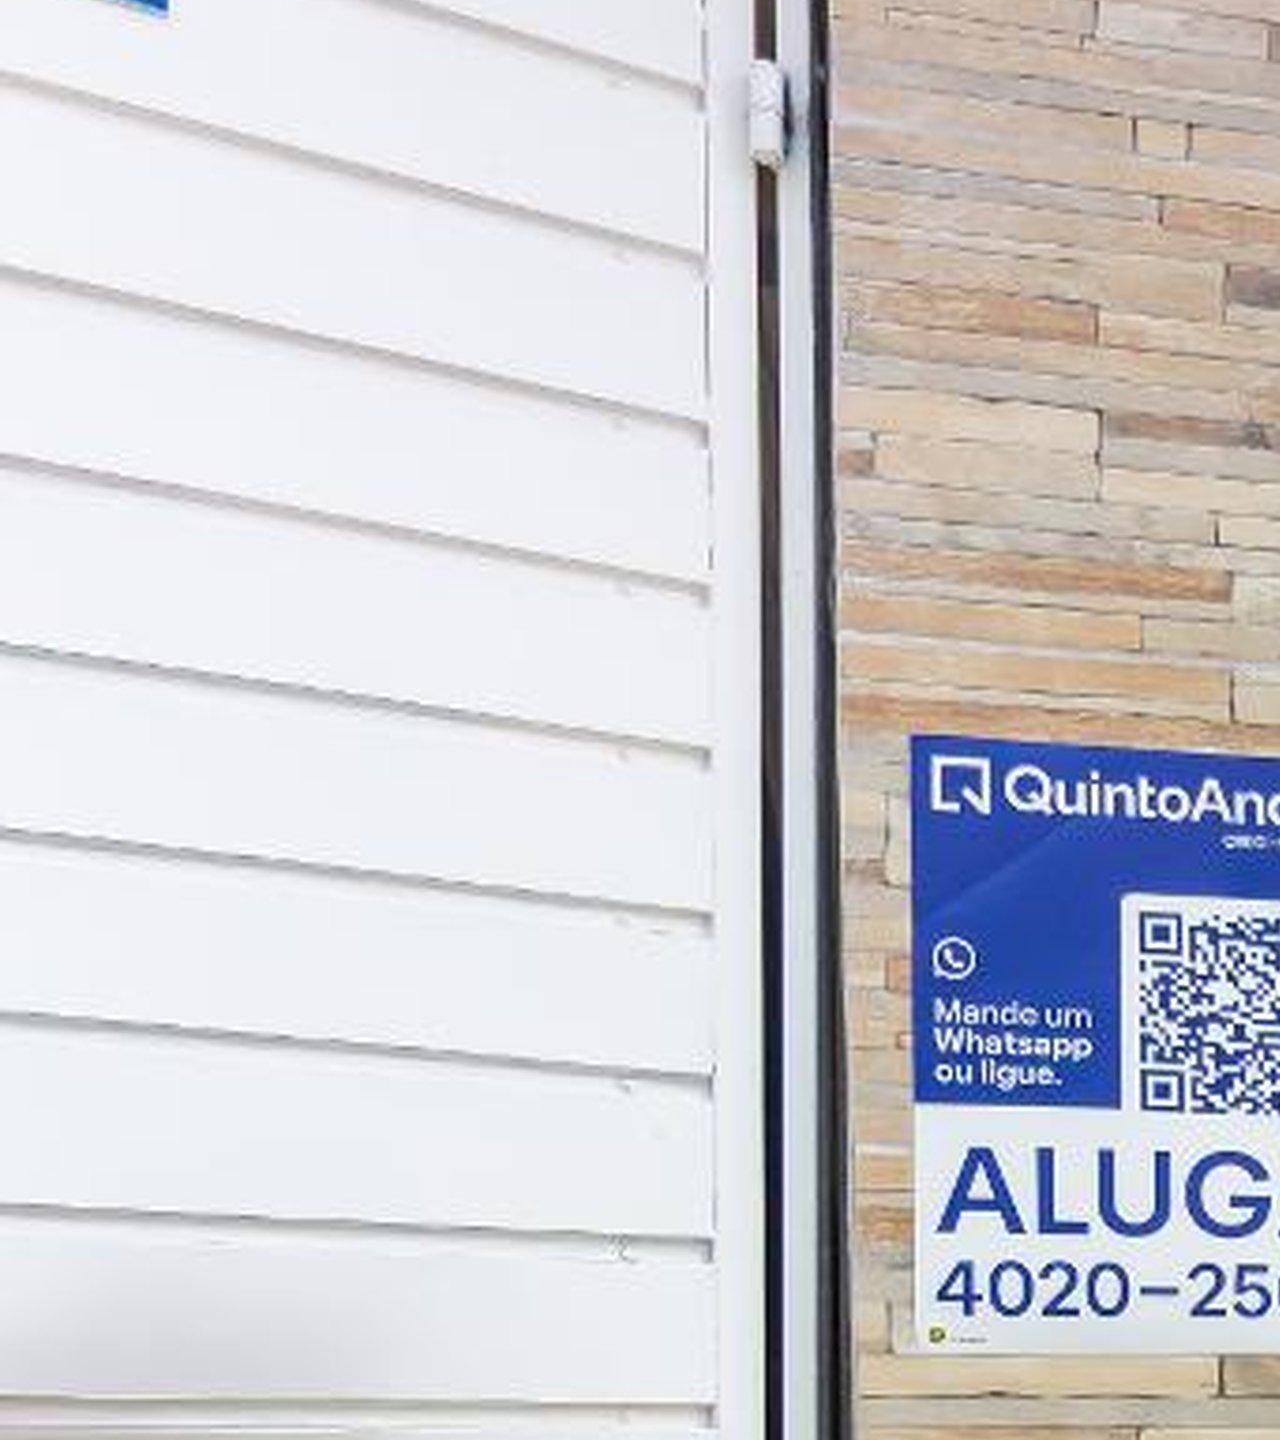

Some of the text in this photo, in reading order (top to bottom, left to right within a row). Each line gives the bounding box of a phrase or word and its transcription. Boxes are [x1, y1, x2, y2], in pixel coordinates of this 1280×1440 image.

[933, 997, 1093, 1029] Mande um
[933, 1027, 1094, 1062] Whatsapp
[933, 1058, 1063, 1092] ou ligue.
